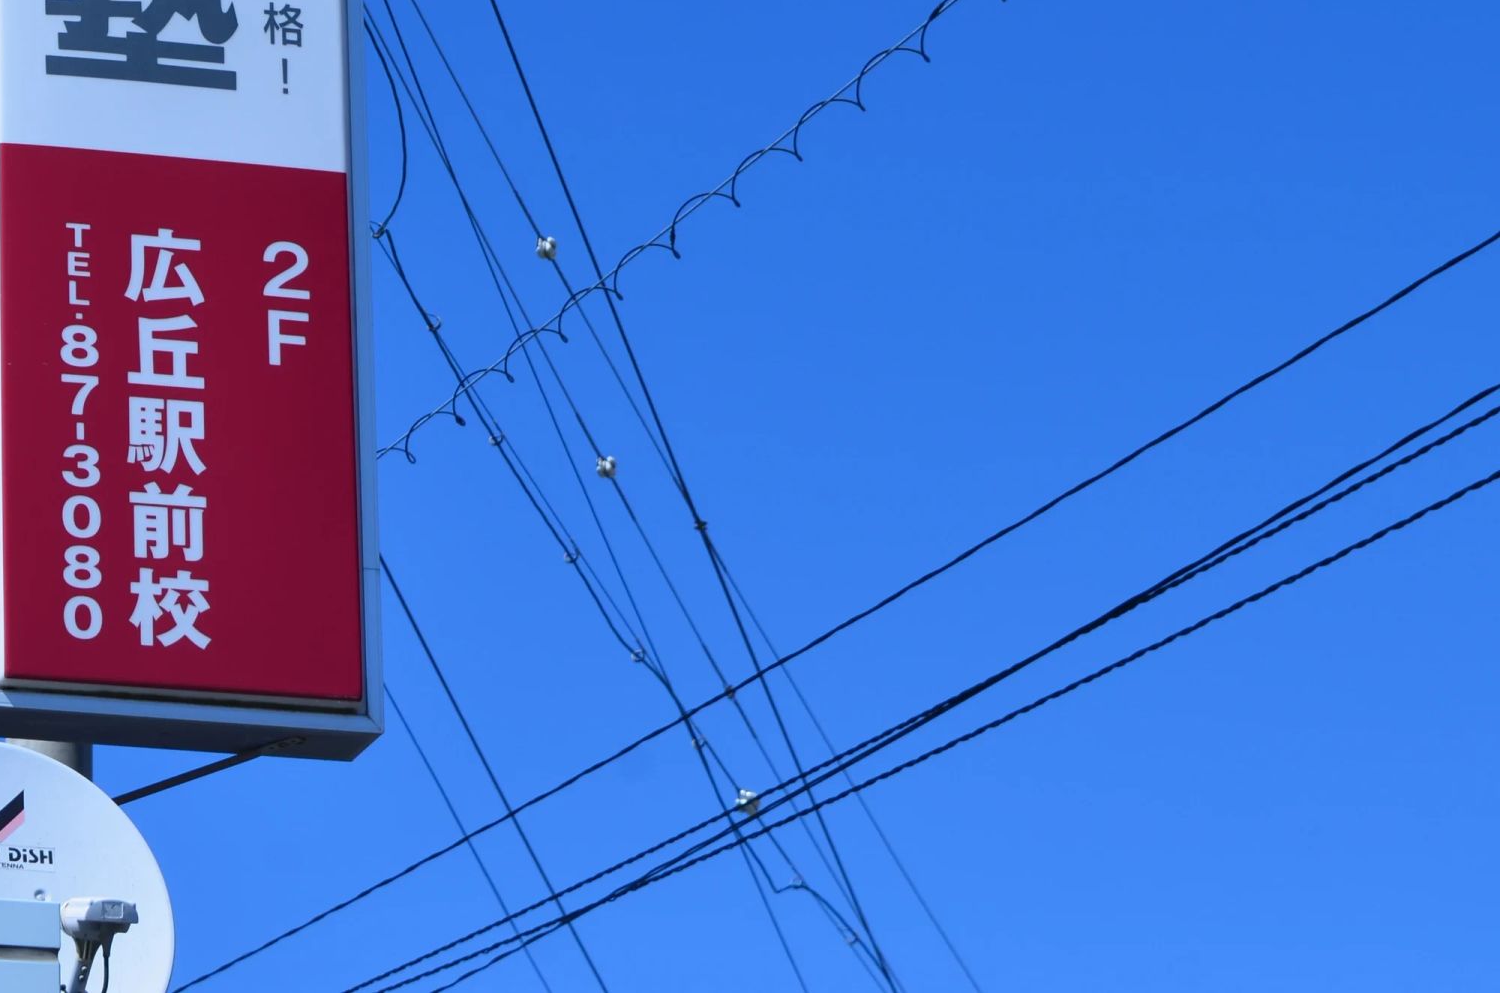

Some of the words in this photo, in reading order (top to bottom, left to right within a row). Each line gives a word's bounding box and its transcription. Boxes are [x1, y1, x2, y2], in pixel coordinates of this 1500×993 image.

[124, 228, 212, 650] 広丘駅前校
[262, 240, 311, 367] 2F
